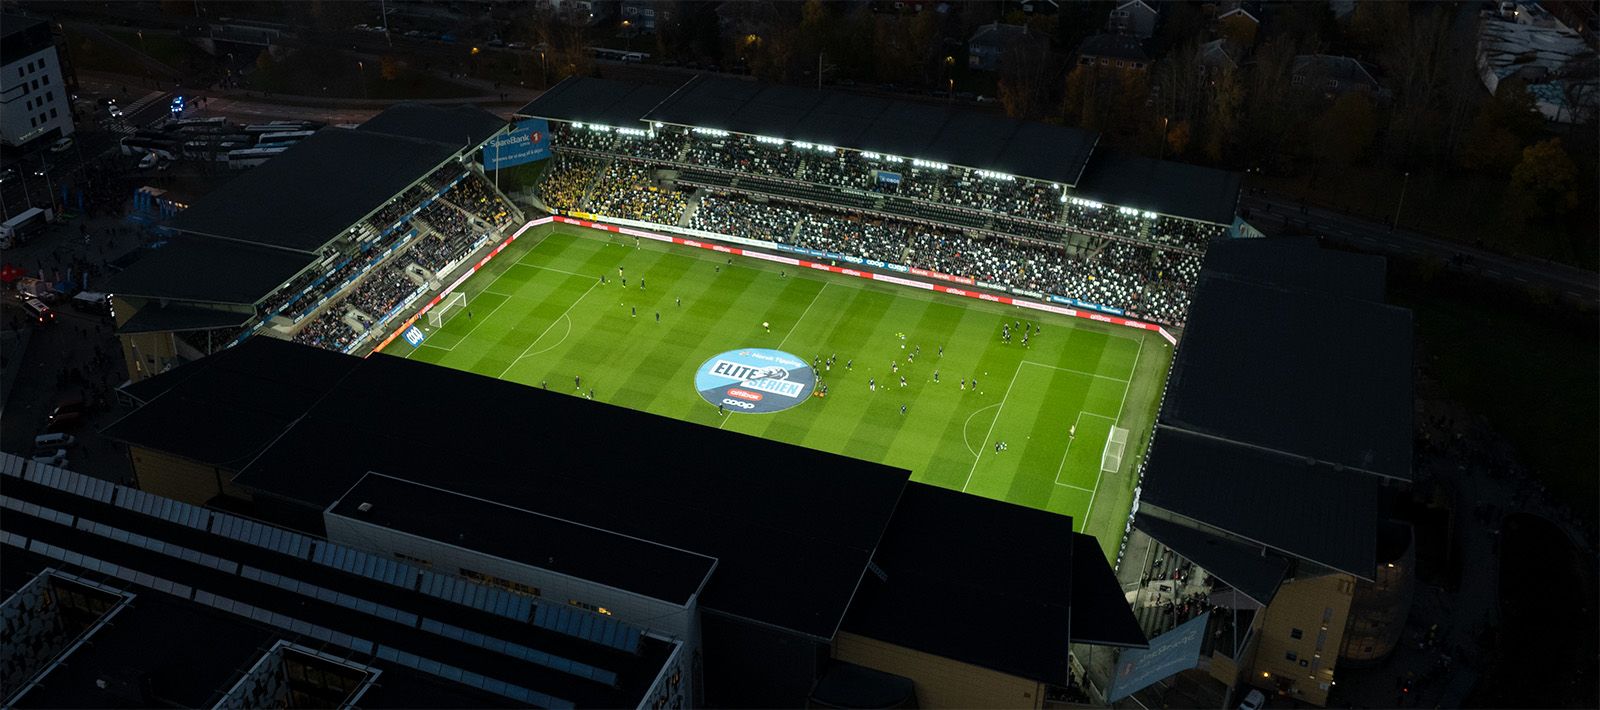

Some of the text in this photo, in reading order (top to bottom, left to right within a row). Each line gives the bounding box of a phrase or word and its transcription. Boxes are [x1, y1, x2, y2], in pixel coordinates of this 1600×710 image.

[845, 255, 908, 273] coop coop coop
[714, 362, 759, 380] ELITE
[731, 389, 760, 400] altibox
[749, 379, 799, 395] SERIEN
[722, 398, 755, 409] coop
